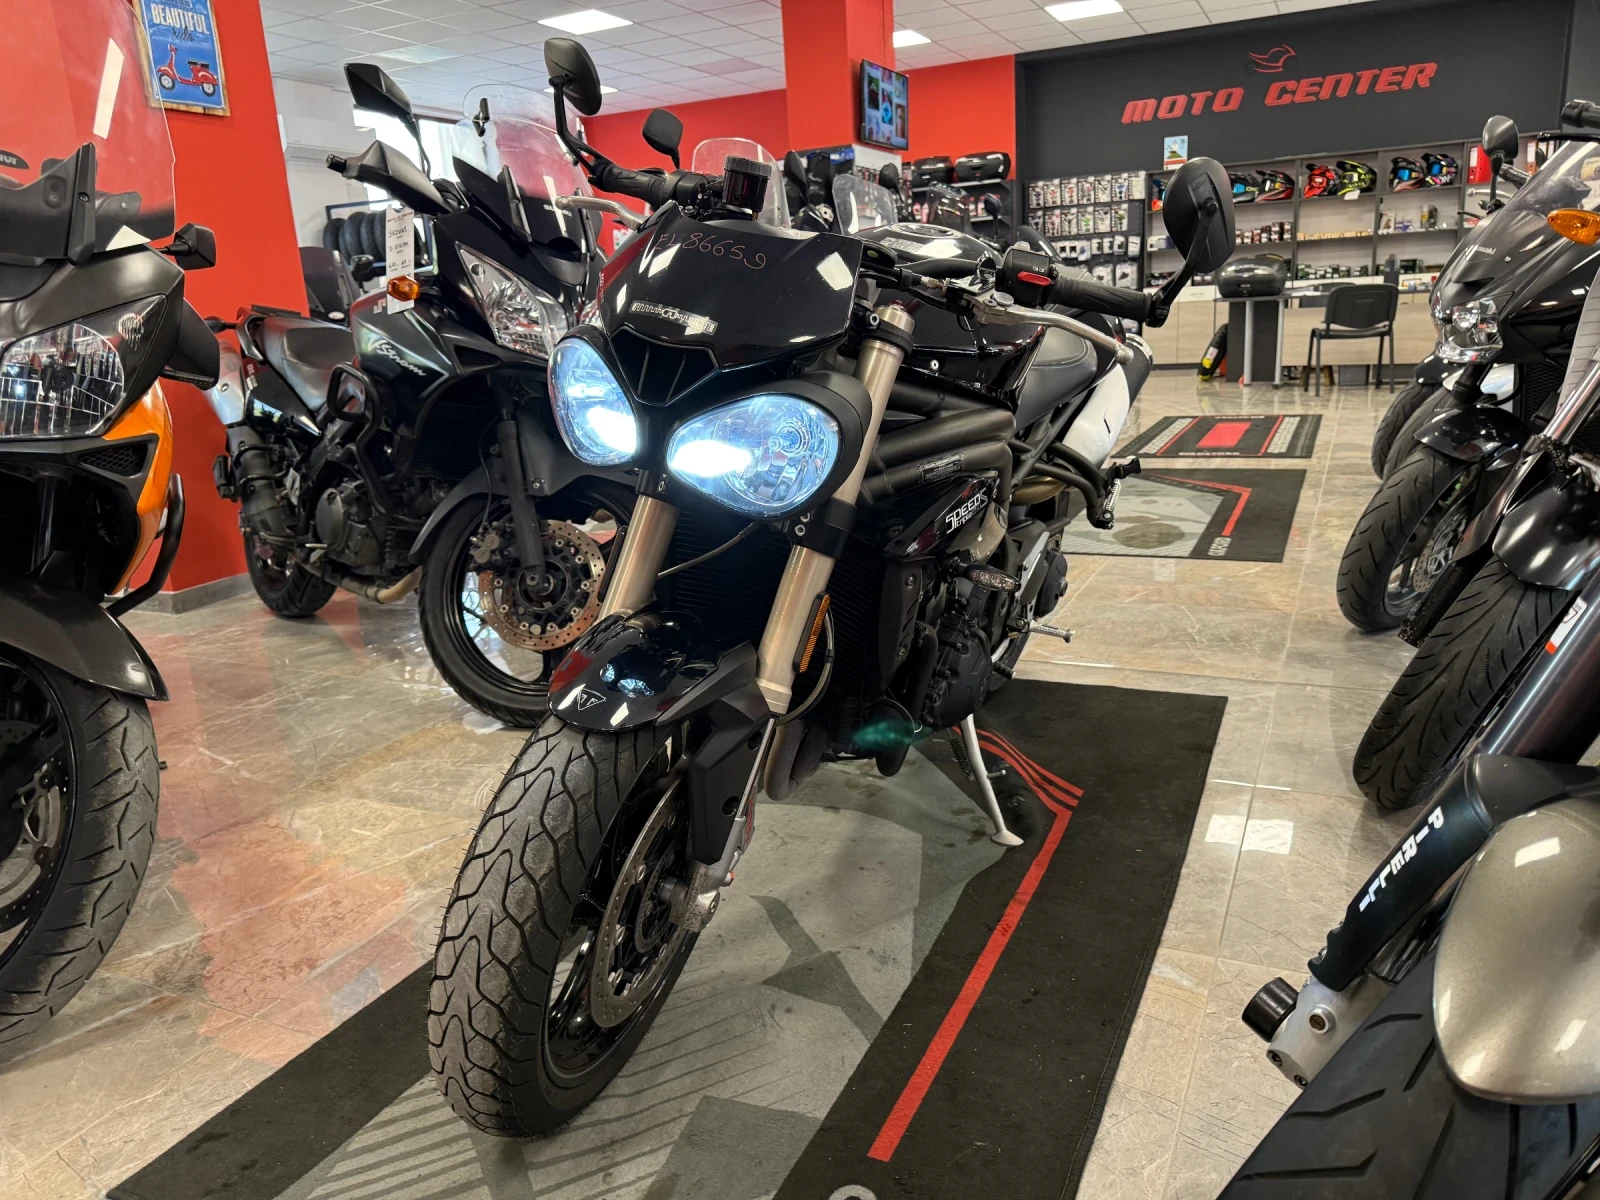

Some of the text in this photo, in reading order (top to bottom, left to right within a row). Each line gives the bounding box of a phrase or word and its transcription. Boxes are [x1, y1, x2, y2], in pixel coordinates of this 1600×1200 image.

[150, 3, 211, 35] BEAUTIFUL
[1121, 62, 1438, 124] MOTO CENTER
[1358, 805, 1445, 913] PIRELLI
